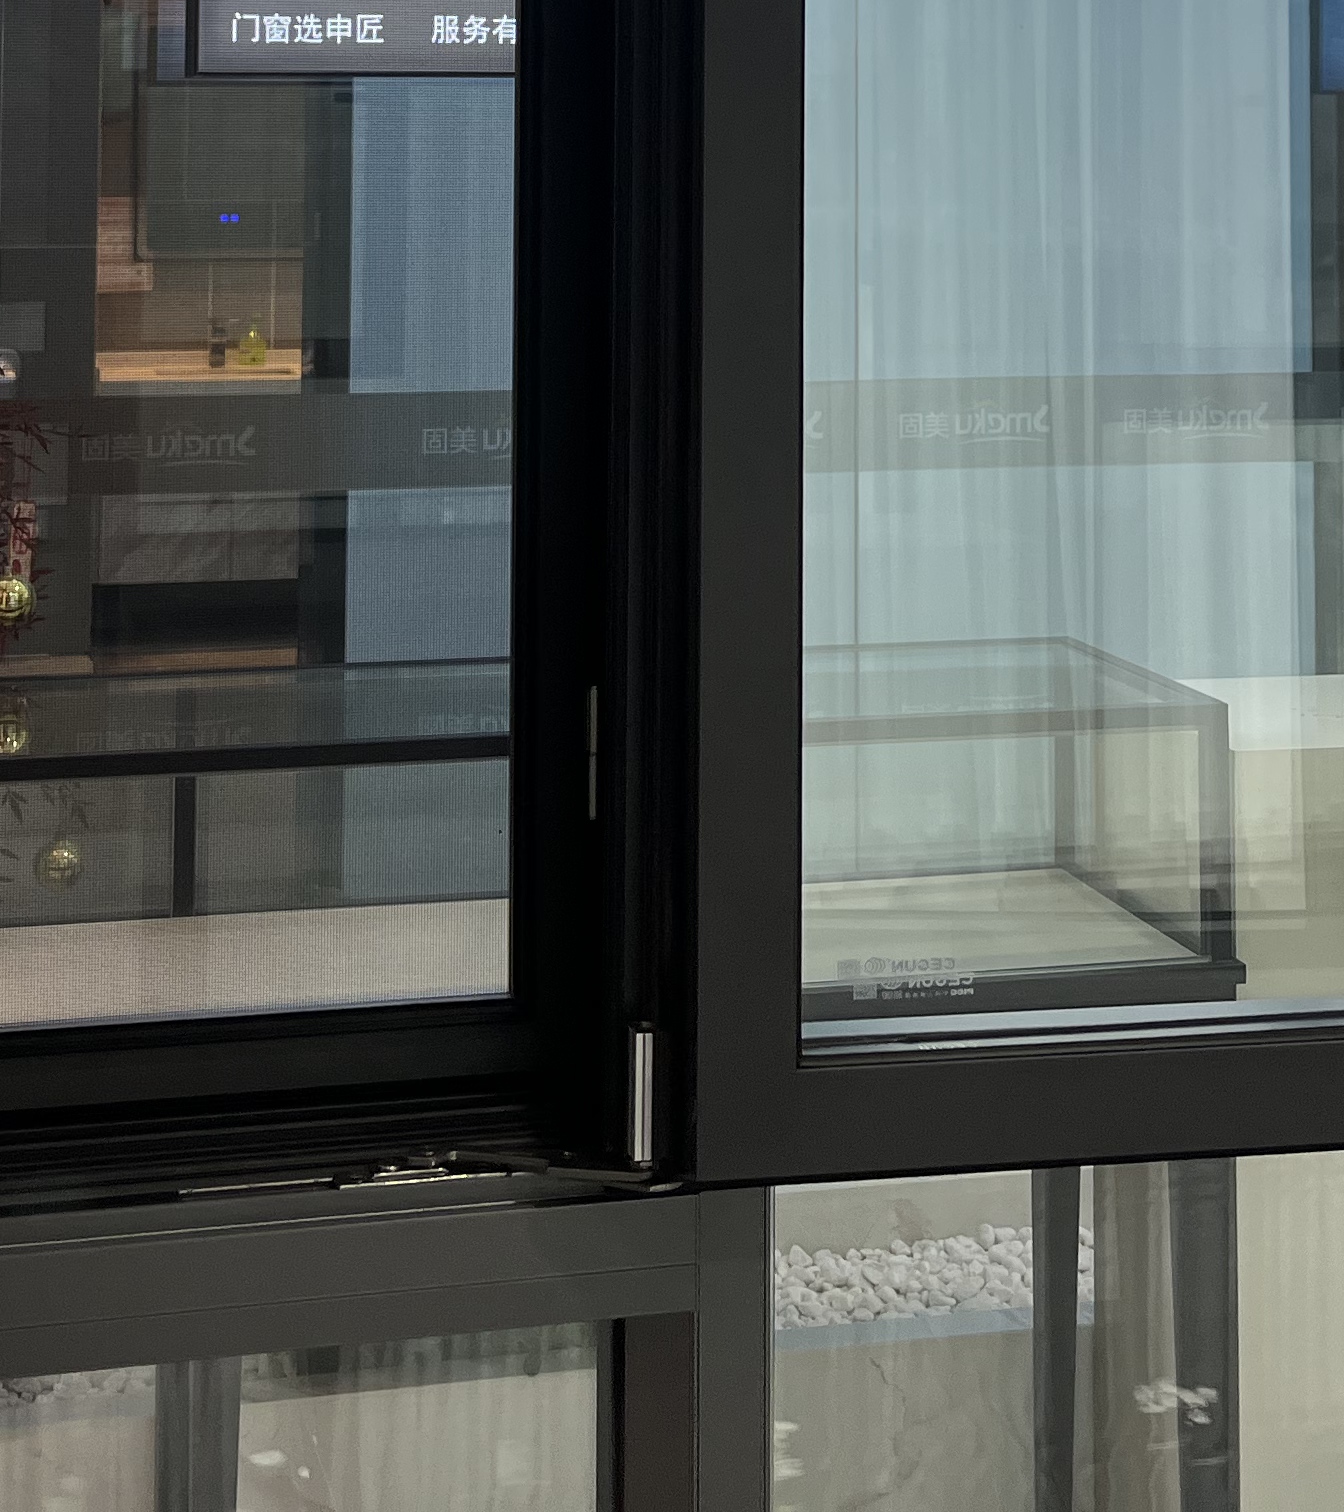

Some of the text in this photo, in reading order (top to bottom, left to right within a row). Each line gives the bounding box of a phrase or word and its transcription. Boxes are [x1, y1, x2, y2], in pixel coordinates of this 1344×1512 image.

[231, 12, 517, 45] 门窗选申匠 服务有
